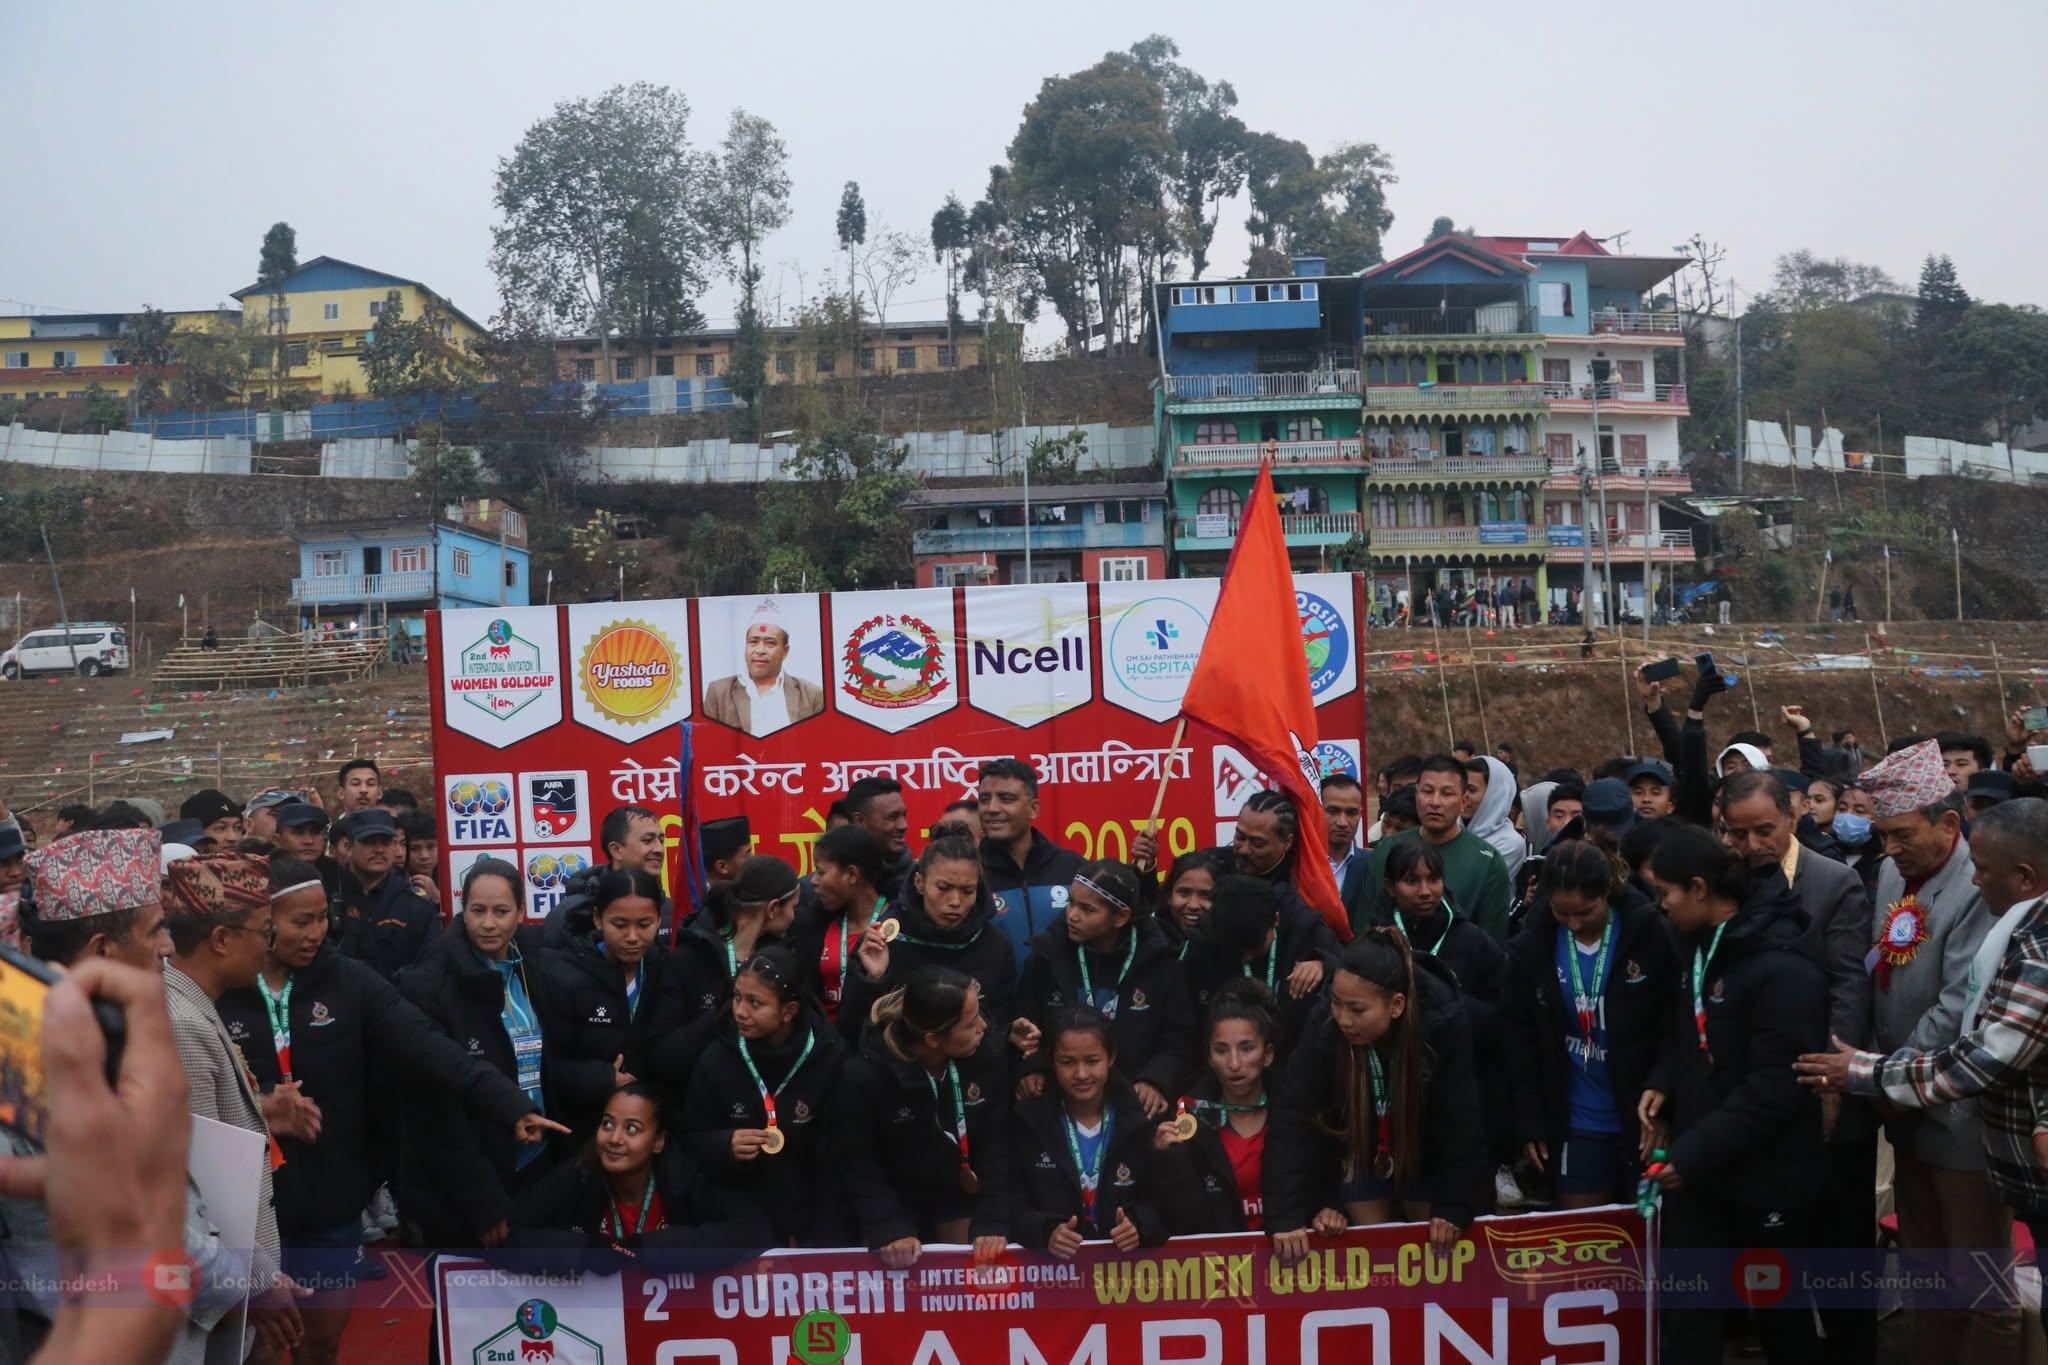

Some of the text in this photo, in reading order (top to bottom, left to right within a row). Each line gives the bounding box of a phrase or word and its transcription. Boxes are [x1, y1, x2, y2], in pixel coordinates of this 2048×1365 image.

[1296, 593, 1339, 632] Oasis
[468, 661, 506, 674] INTERNATIONAL
[469, 652, 487, 661] 2nd
[975, 636, 1085, 675] Ncell
[450, 675, 554, 691] WOMEN GOLDCUP
[592, 660, 669, 687] Yashoda
[613, 677, 653, 688] FOODS
[1311, 669, 1336, 690] 072
[1324, 744, 1352, 768] Oasis
[703, 752, 806, 796] करेन्ट
[455, 818, 511, 840] FIFA
[1505, 1237, 1625, 1270] करेन्ट
[920, 1263, 1081, 1287] INTERNATIONAL
[1092, 1239, 1477, 1305] WOMEN GOLD-CUP
[712, 1269, 910, 1319] CURRENT
[921, 1291, 1035, 1313] INVITATION
[487, 1349, 515, 1362] 2nd
